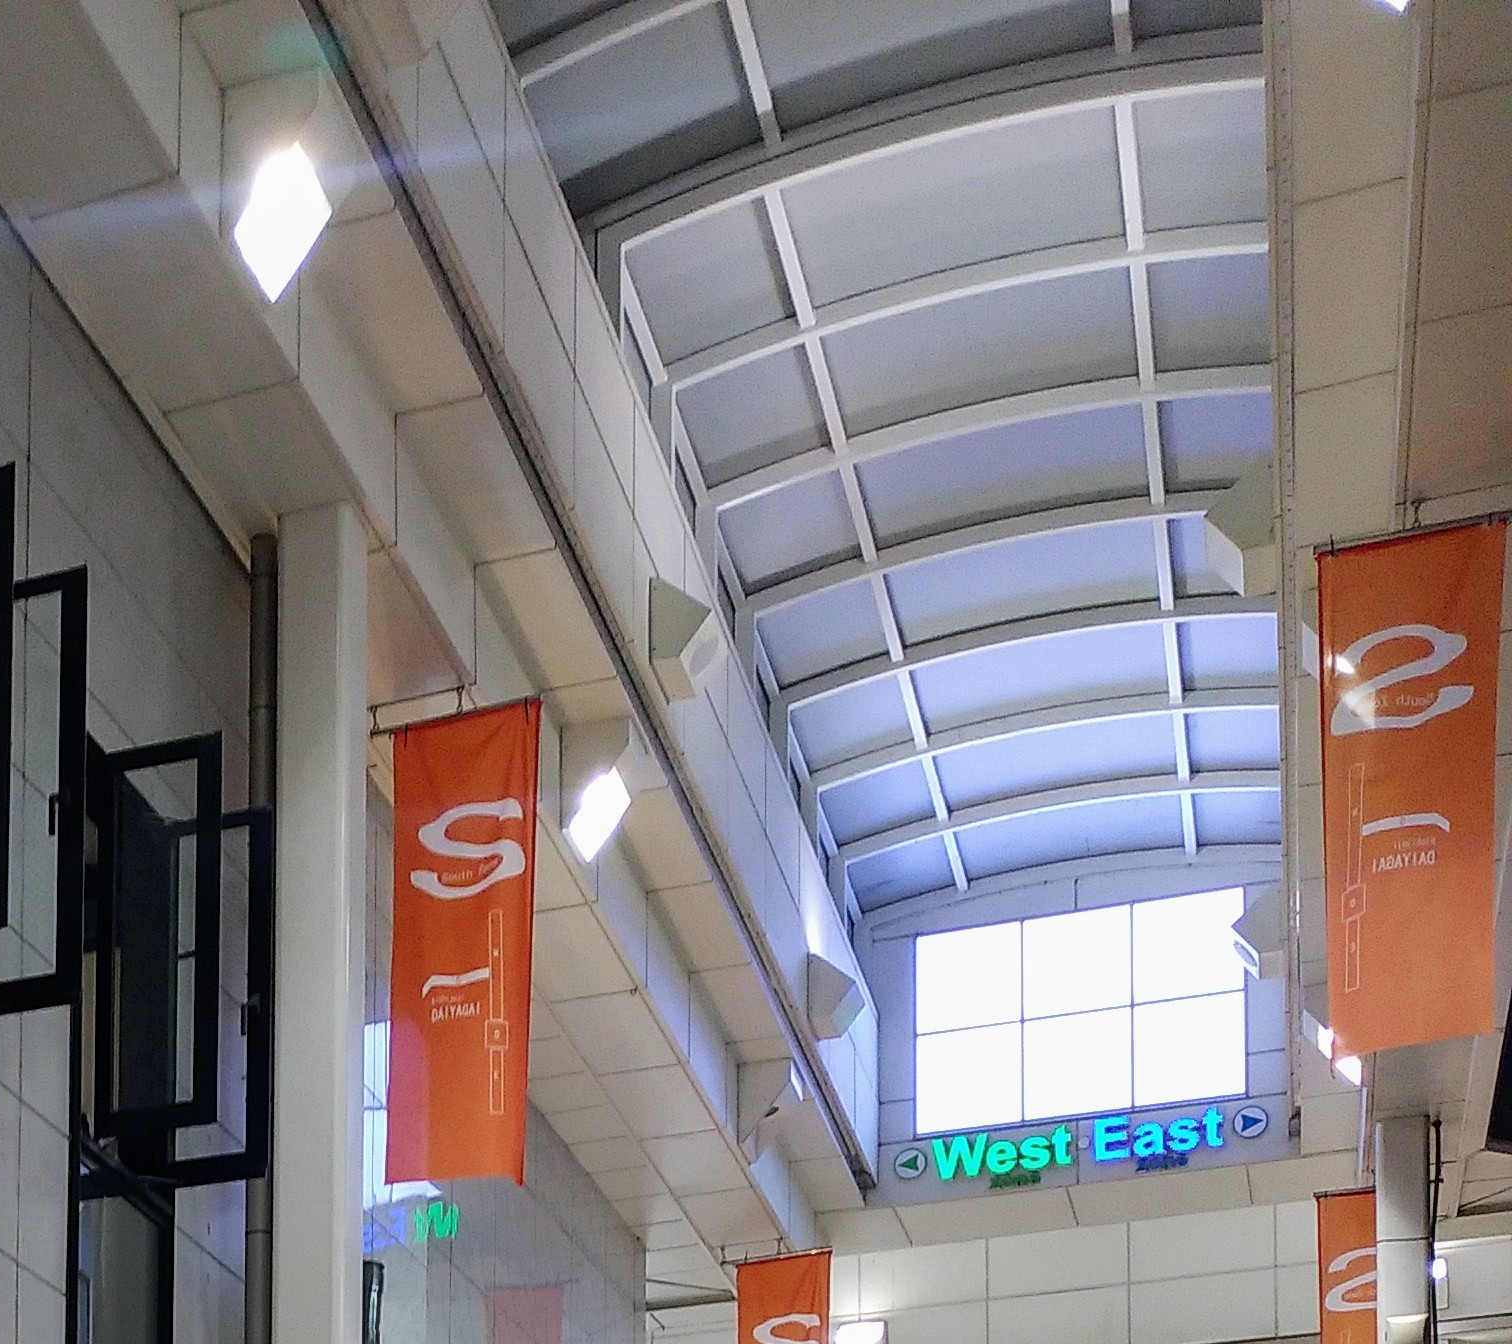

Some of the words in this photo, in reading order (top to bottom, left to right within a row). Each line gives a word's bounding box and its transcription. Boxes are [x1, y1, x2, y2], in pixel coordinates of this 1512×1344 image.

[409, 796, 527, 900] S
[931, 1124, 1073, 1181] West
[1093, 1106, 1225, 1163] East
